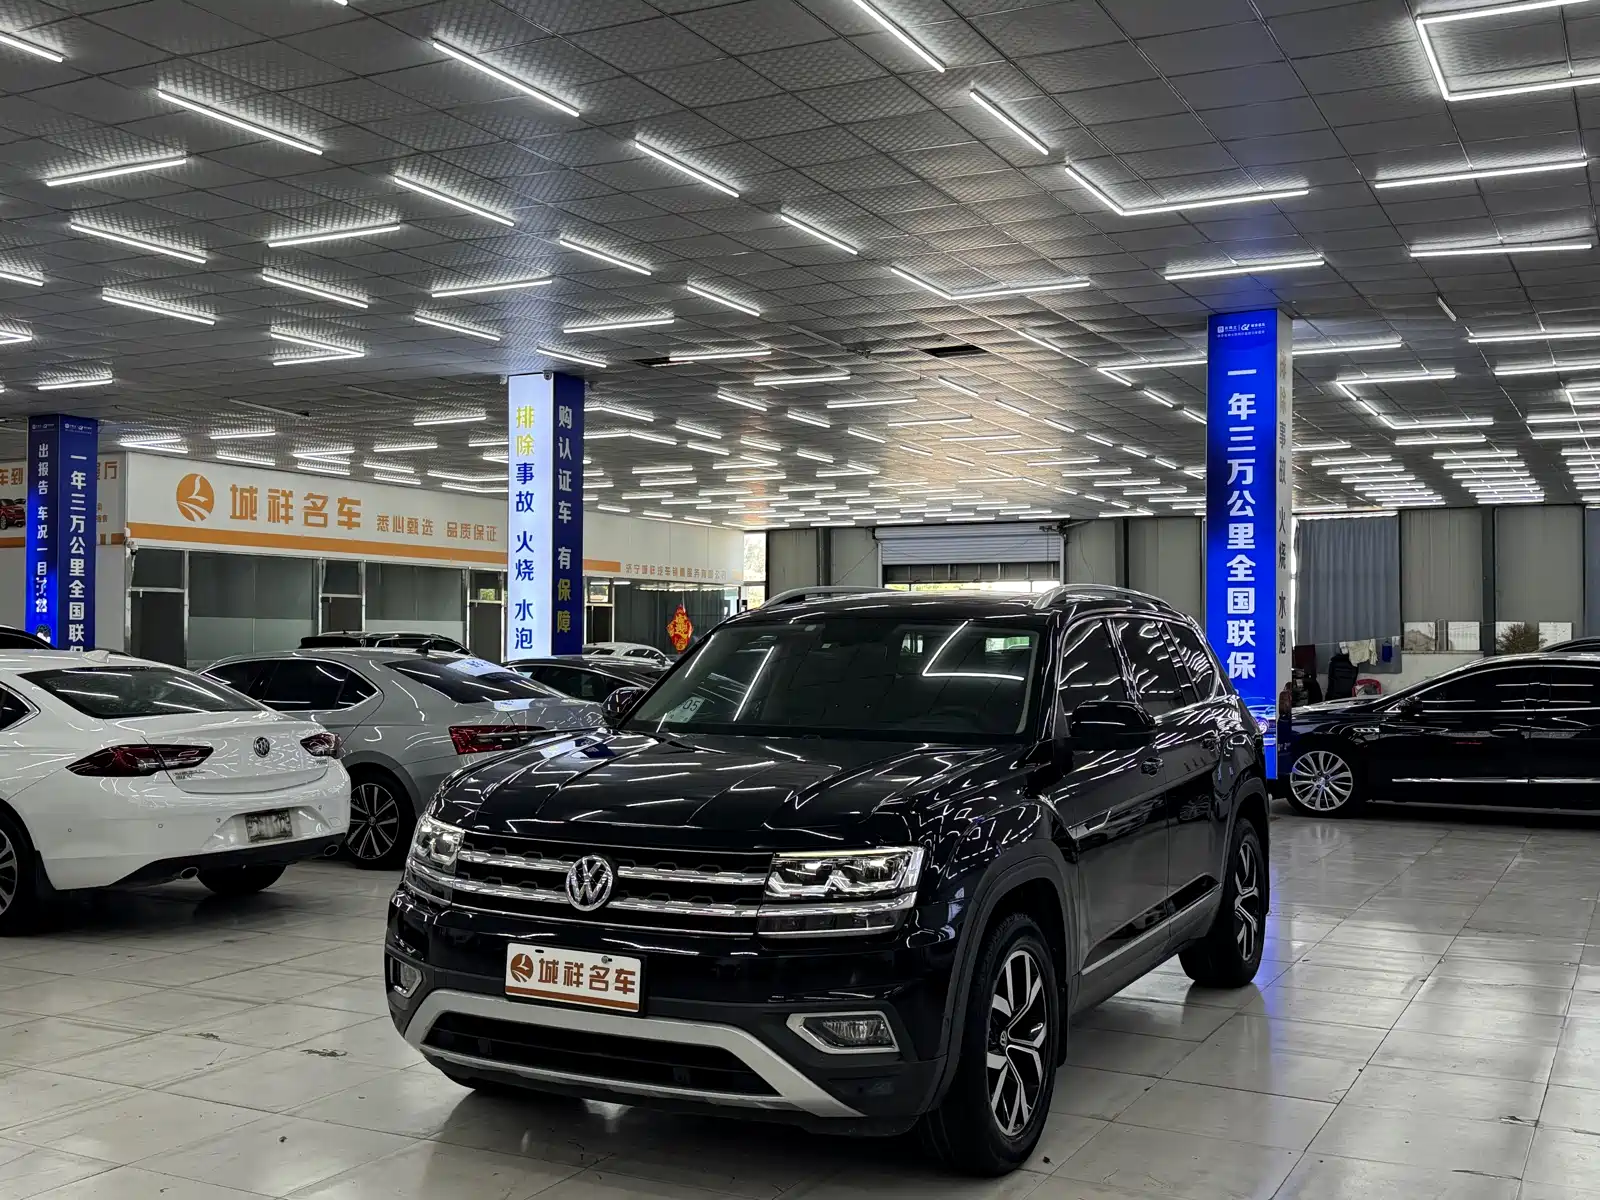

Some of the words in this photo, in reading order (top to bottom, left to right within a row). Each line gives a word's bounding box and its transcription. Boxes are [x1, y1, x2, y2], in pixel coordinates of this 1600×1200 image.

[37, 443, 49, 496] 出报告
[515, 405, 535, 513] 排除事故
[558, 405, 573, 524] 购认证车
[230, 483, 362, 530] 城祥名车
[376, 514, 434, 536] 悉心甄选
[446, 521, 499, 542] 品质保证
[1226, 368, 1257, 680] 一年三万公里全国联保
[36, 506, 49, 613] 车况一目了然
[515, 530, 535, 581] 火烧
[1278, 506, 1287, 569] 火烧
[557, 546, 572, 633] 有保障
[514, 598, 534, 650] 水泡
[537, 957, 636, 995] 城祥名车
